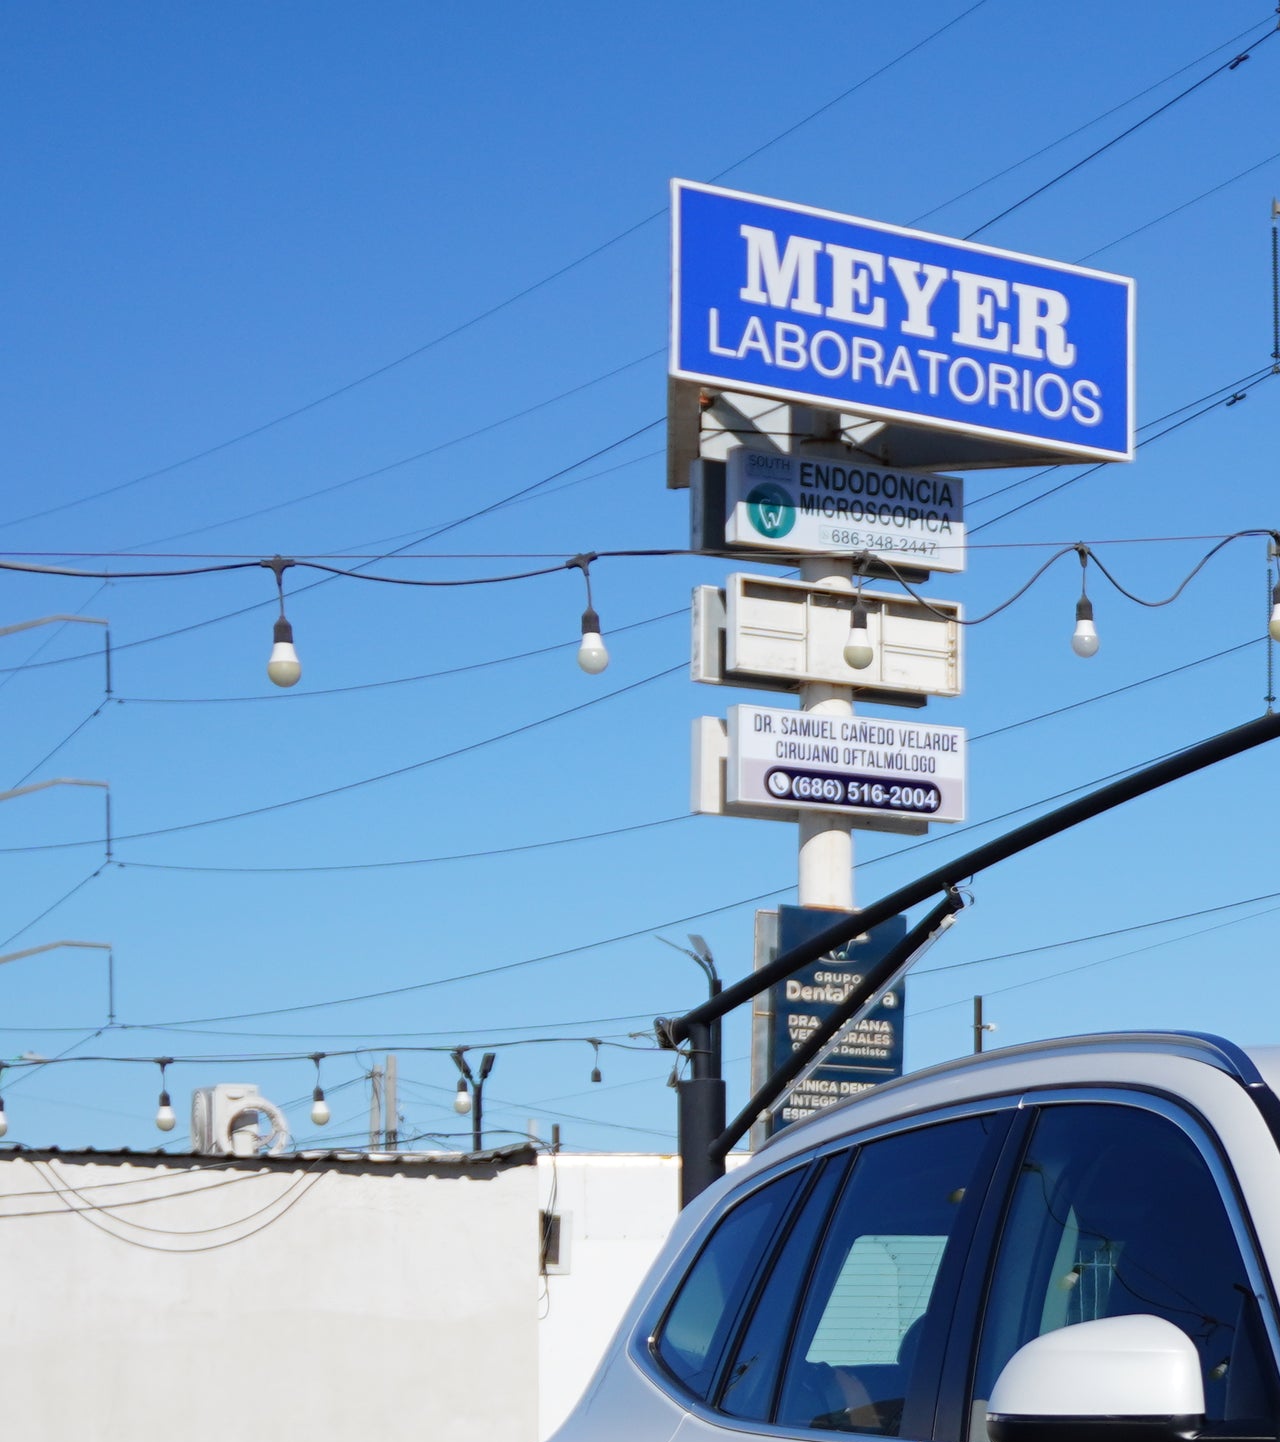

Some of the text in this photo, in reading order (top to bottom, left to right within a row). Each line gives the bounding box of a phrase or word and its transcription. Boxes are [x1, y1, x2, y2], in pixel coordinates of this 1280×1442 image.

[740, 224, 1077, 368] MEYER
[708, 307, 1104, 428] LABORATORIOS
[749, 454, 791, 472] SOUTH
[799, 462, 954, 508] ENDODONCIA
[799, 492, 953, 535] MICROSCOPICA
[831, 529, 937, 556] 686-348-2447
[753, 713, 959, 753] DR. SAMUEL CAÑEDO VELARDE
[775, 741, 936, 774] CIRUJANO OFTALMÓLOGO
[791, 775, 938, 809] (686) 516-2004
[813, 970, 861, 984] GRUPO
[840, 1045, 888, 1057] Dentista
[786, 1079, 838, 1093] LINICA
